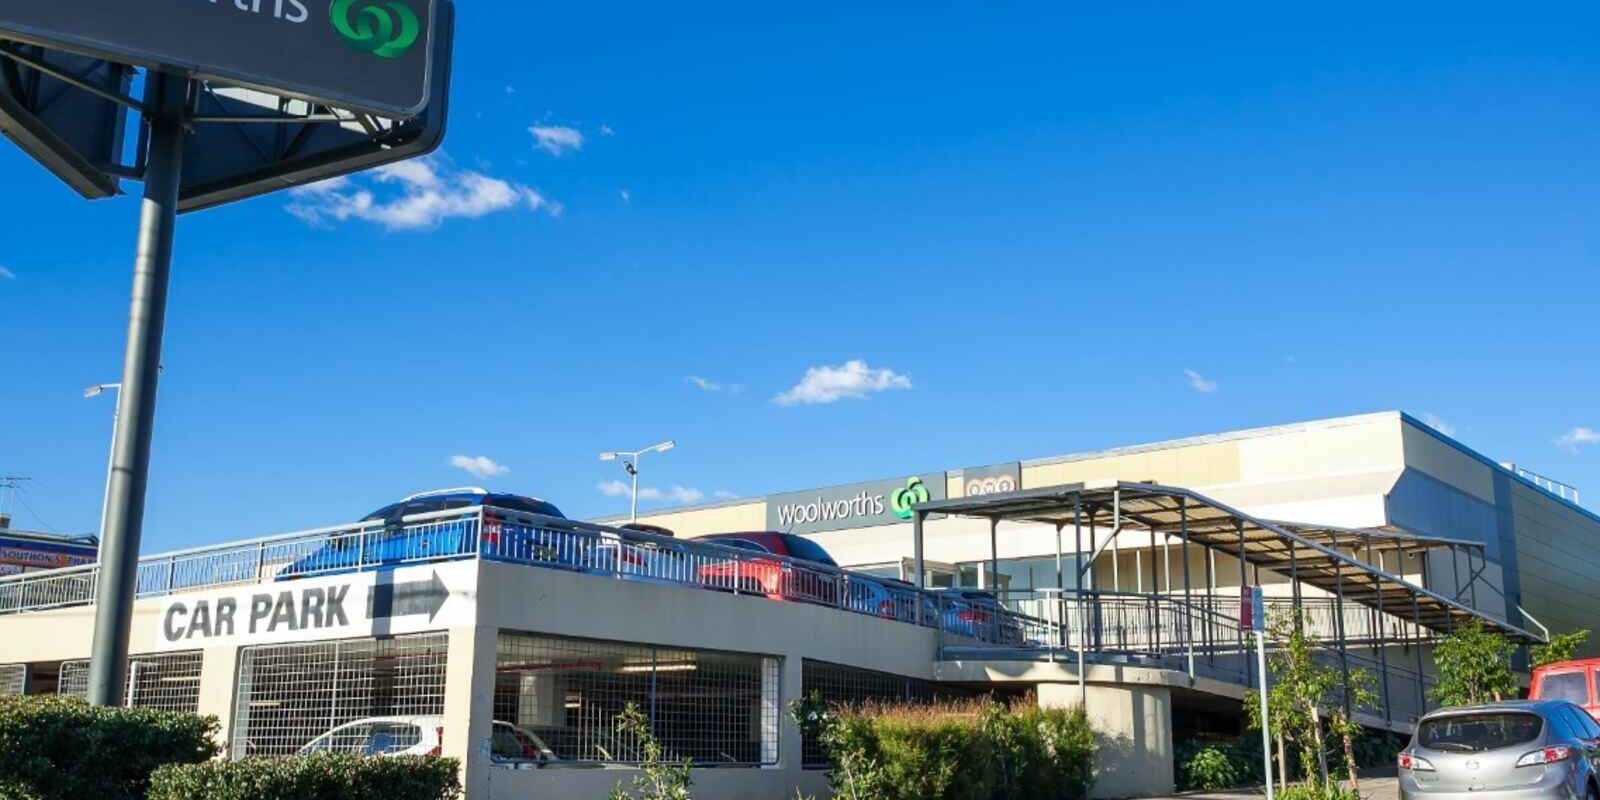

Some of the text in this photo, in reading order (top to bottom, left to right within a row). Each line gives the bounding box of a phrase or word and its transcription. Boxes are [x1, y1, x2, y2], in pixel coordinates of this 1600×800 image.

[777, 490, 884, 526] Woolworths
[164, 584, 351, 641] CAR PARK
